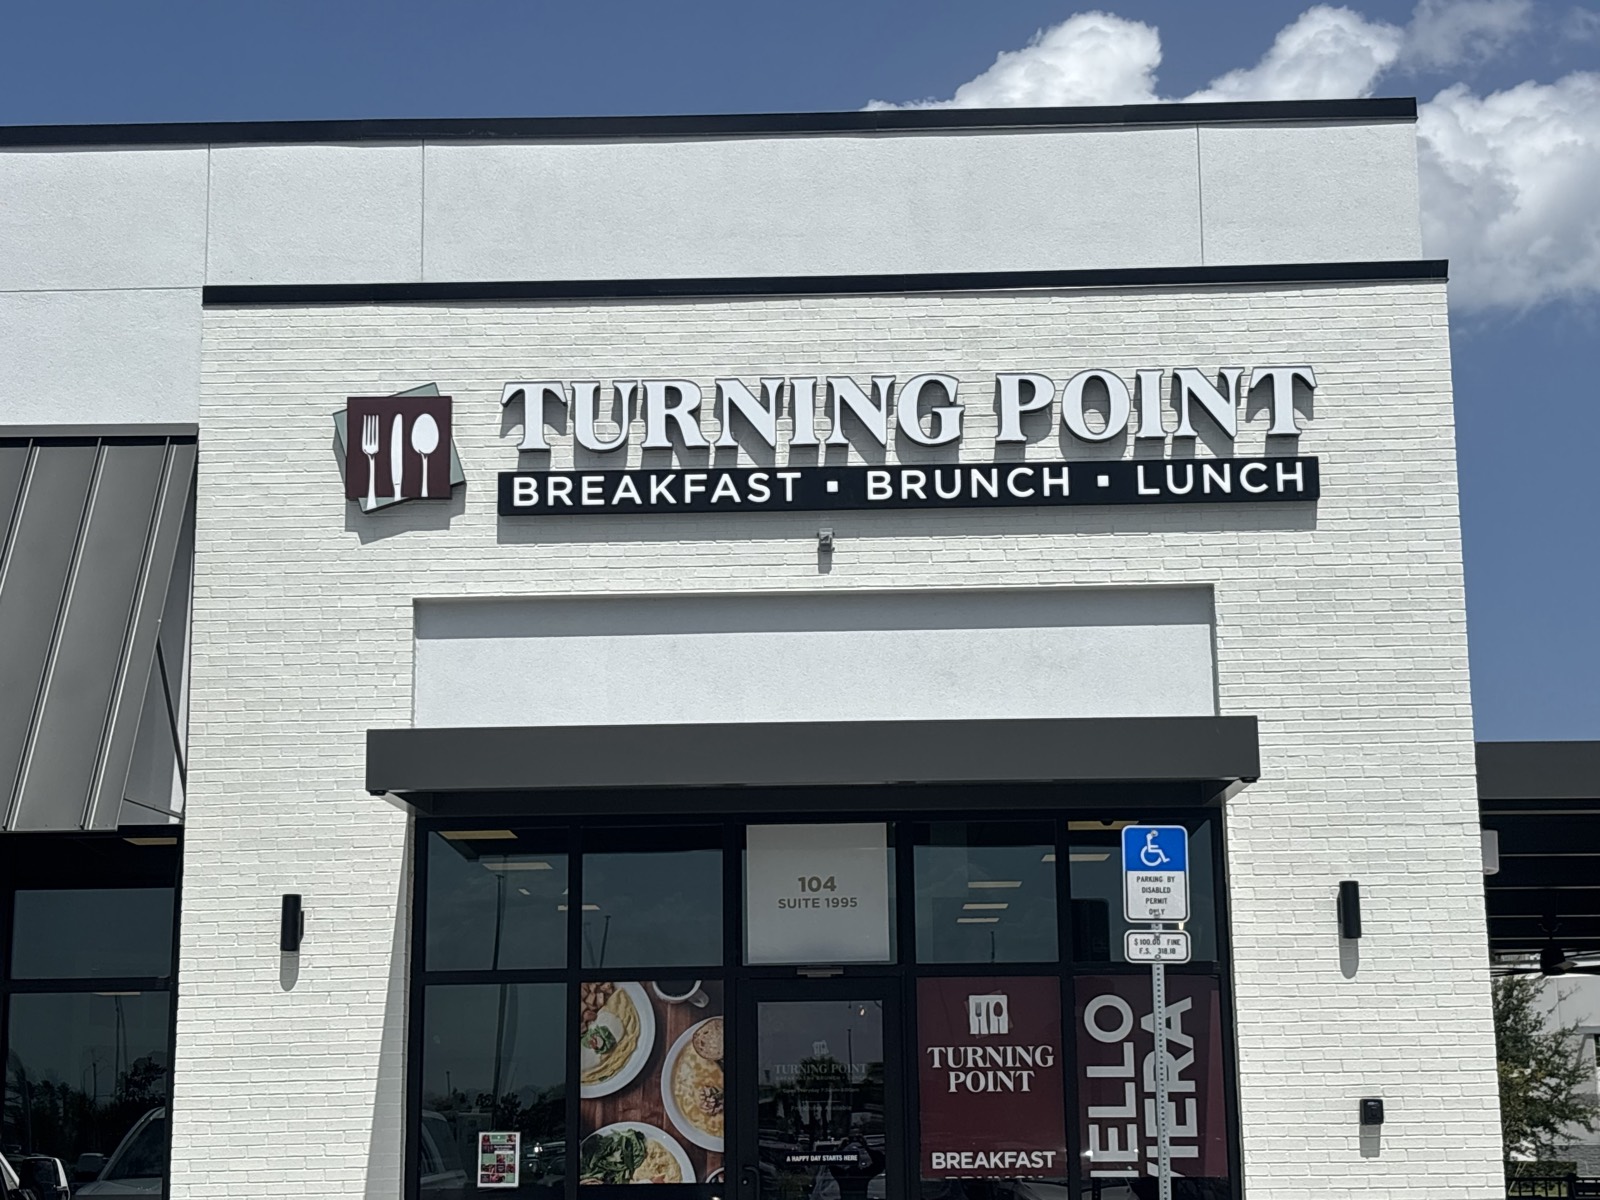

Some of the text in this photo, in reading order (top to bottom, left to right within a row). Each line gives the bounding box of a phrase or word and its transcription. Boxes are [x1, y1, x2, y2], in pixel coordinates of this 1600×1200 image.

[500, 366, 1317, 452] TURNING POINT
[513, 462, 1304, 506] BREAKFAST BRUNCH LUNCH
[798, 876, 837, 892] 104
[778, 897, 858, 909] SUITE 1995
[1167, 938, 1182, 946] FINE
[927, 1046, 1055, 1068] TURNING
[774, 1063, 867, 1074] TURNING POINT
[948, 1070, 1035, 1093] POINT
[1140, 996, 1199, 1177] IERA
[932, 1151, 1056, 1169] BREAKFAST
